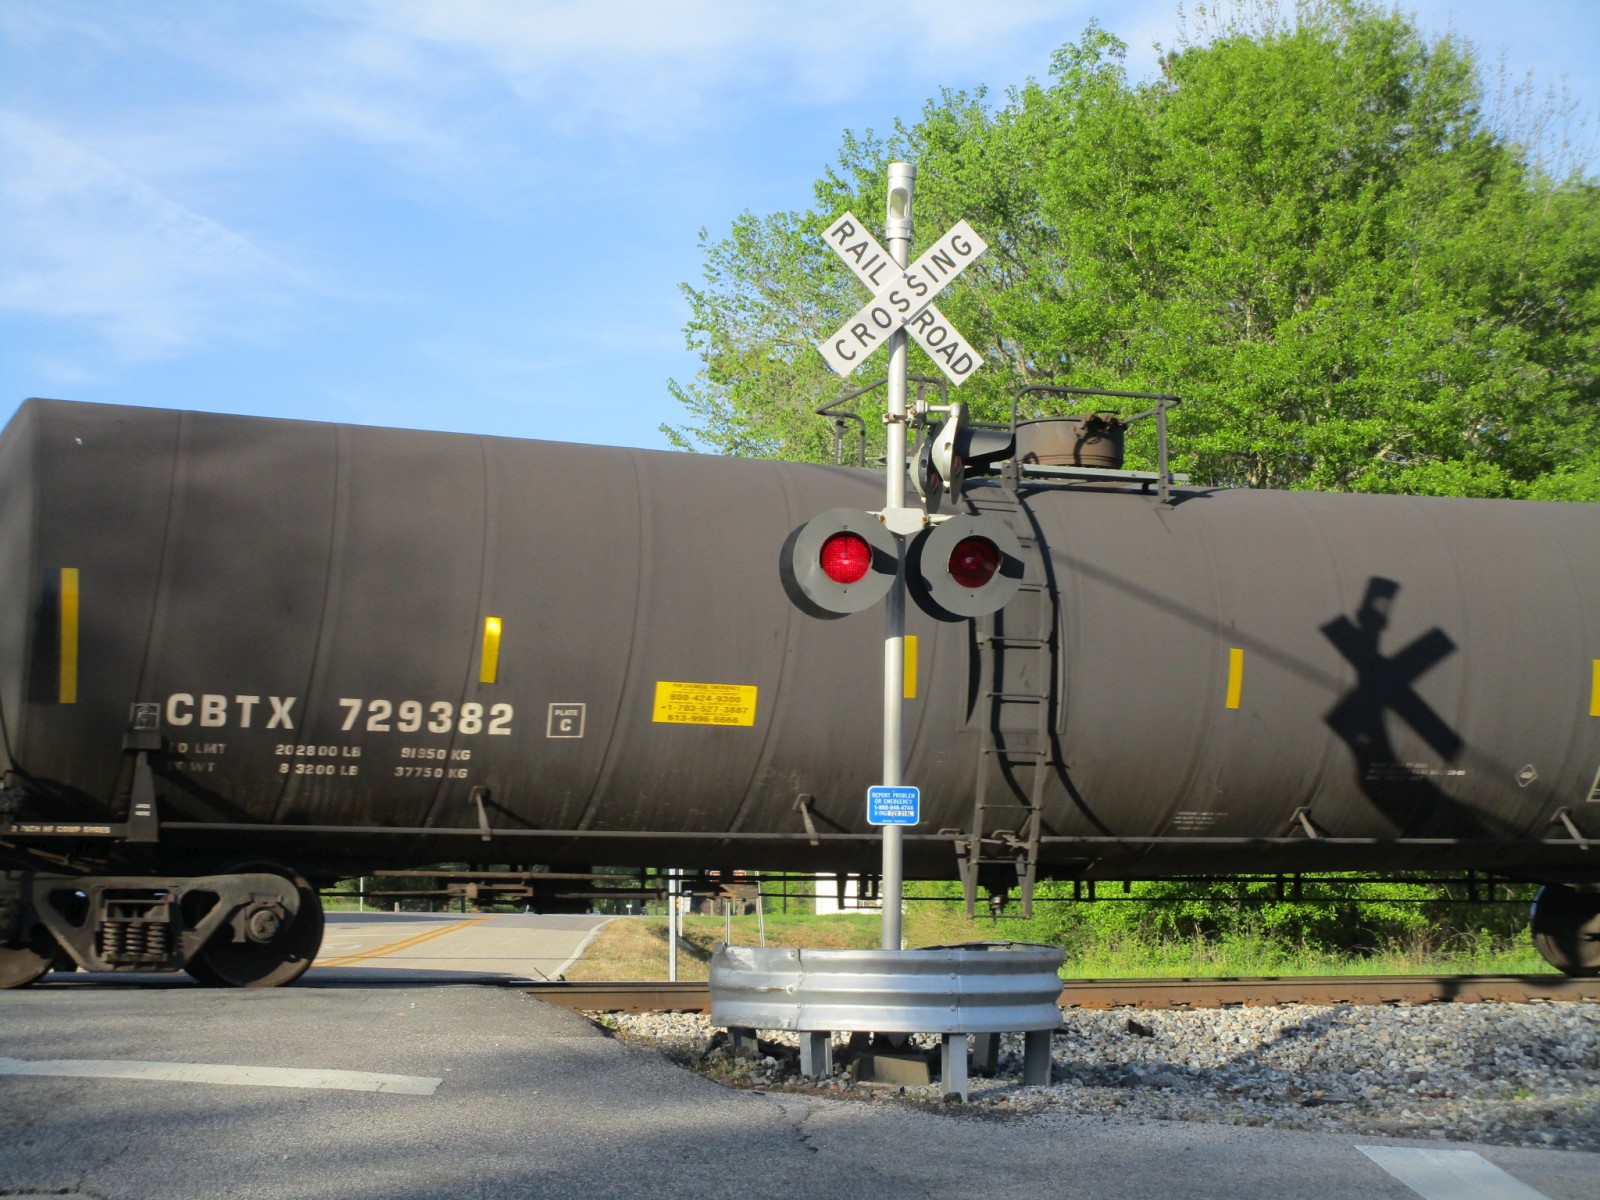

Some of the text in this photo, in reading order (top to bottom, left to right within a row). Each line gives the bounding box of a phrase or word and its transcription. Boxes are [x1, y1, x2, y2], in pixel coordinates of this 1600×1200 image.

[831, 220, 973, 376] RAIL ROAD
[835, 235, 972, 361] CROSSING
[166, 693, 514, 735] CBTX 729382
[560, 718, 572, 732] C
[195, 742, 227, 754] LMT
[275, 744, 338, 756] 202800
[342, 746, 362, 757] LB
[401, 747, 447, 760] 91950
[450, 749, 472, 760] KG
[340, 765, 359, 776] LB
[394, 766, 444, 778] 37750
[447, 768, 468, 779] KG
